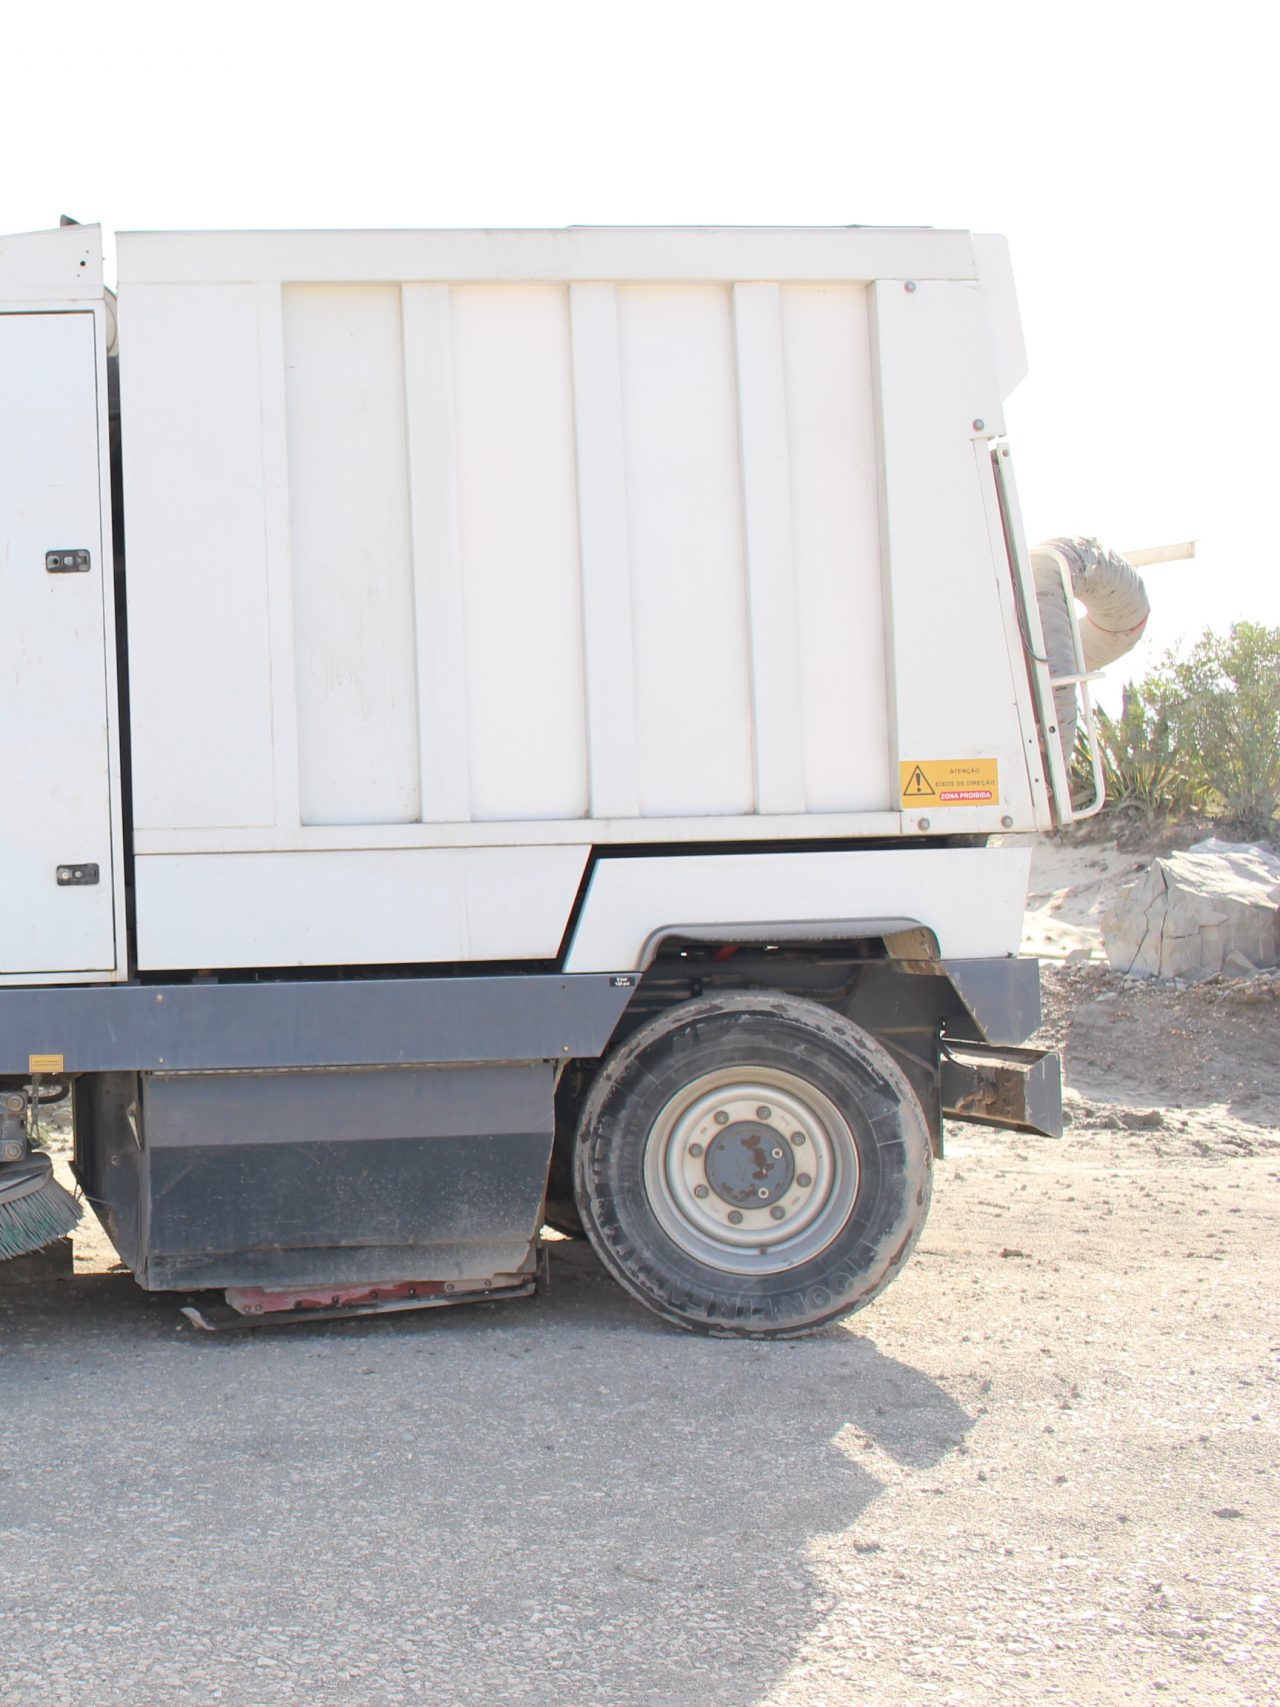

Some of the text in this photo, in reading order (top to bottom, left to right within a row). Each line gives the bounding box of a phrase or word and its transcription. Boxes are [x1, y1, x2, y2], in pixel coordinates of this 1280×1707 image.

[949, 767, 980, 775] ATENÇÃO
[941, 791, 991, 800] ZONA PROIBIDA
